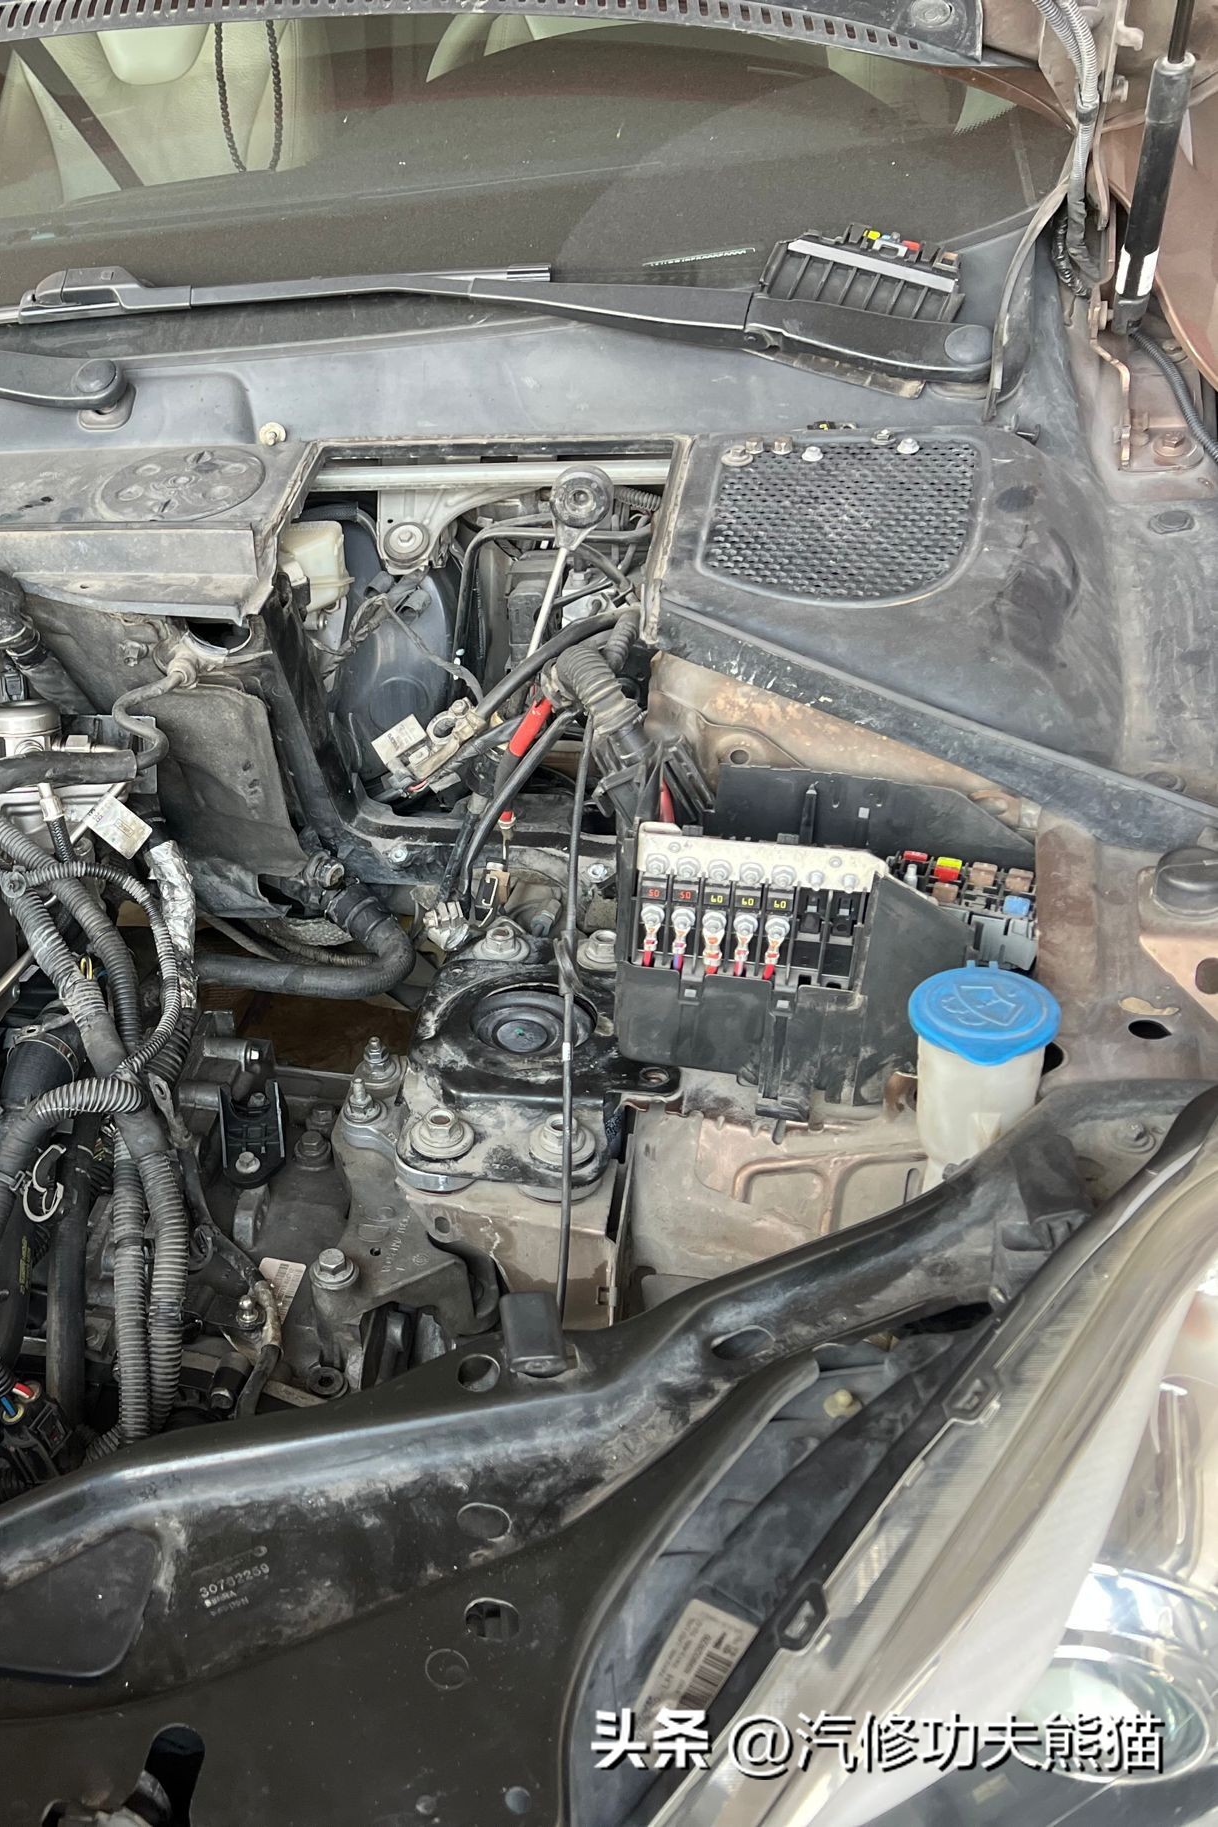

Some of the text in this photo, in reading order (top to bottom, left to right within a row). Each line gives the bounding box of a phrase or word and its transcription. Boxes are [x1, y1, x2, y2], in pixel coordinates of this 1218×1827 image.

[648, 889, 660, 897] 50
[679, 891, 691, 899] 50
[711, 895, 723, 903] 60
[742, 897, 754, 906] 60
[774, 900, 786, 909] 60
